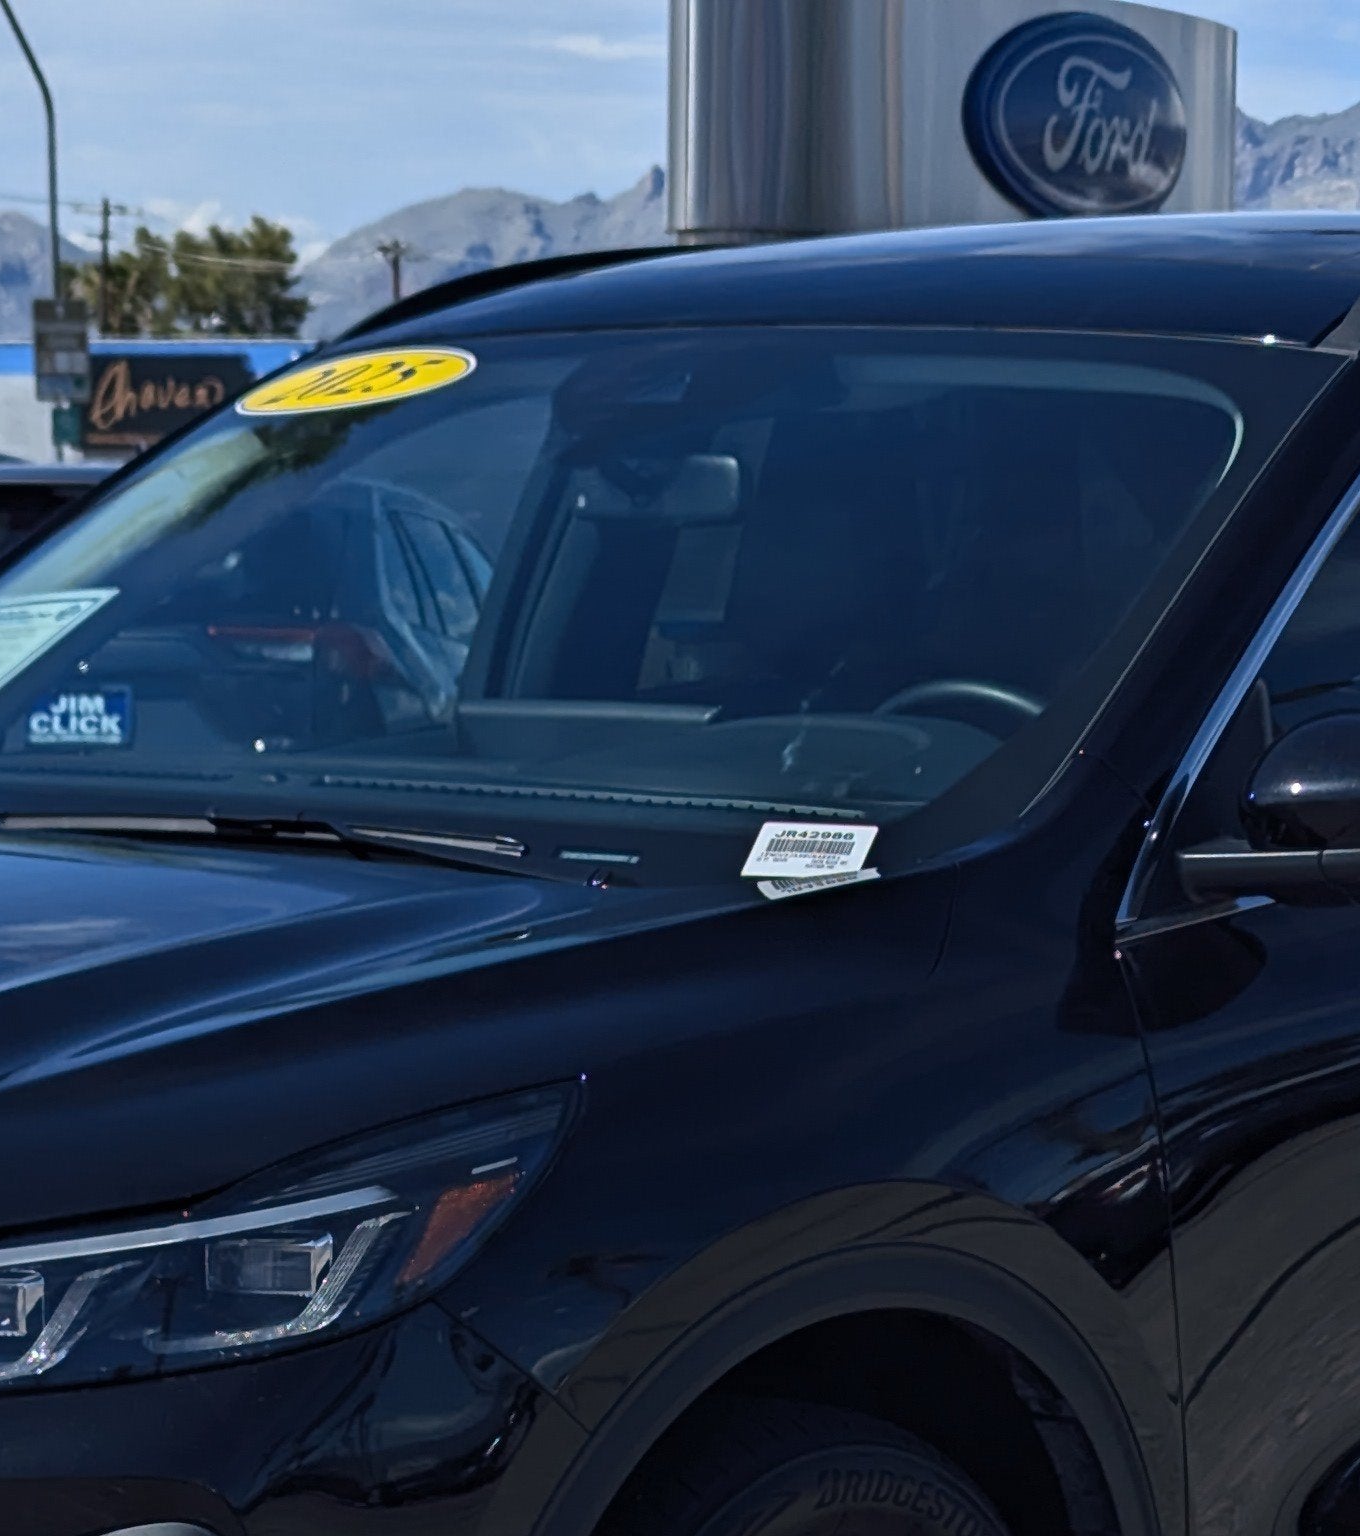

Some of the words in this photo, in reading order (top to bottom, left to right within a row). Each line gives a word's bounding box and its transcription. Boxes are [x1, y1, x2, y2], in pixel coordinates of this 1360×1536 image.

[1043, 55, 1158, 174] Ford
[258, 357, 448, 407] 2025
[50, 695, 104, 713] JIM
[30, 713, 120, 735] CLICK
